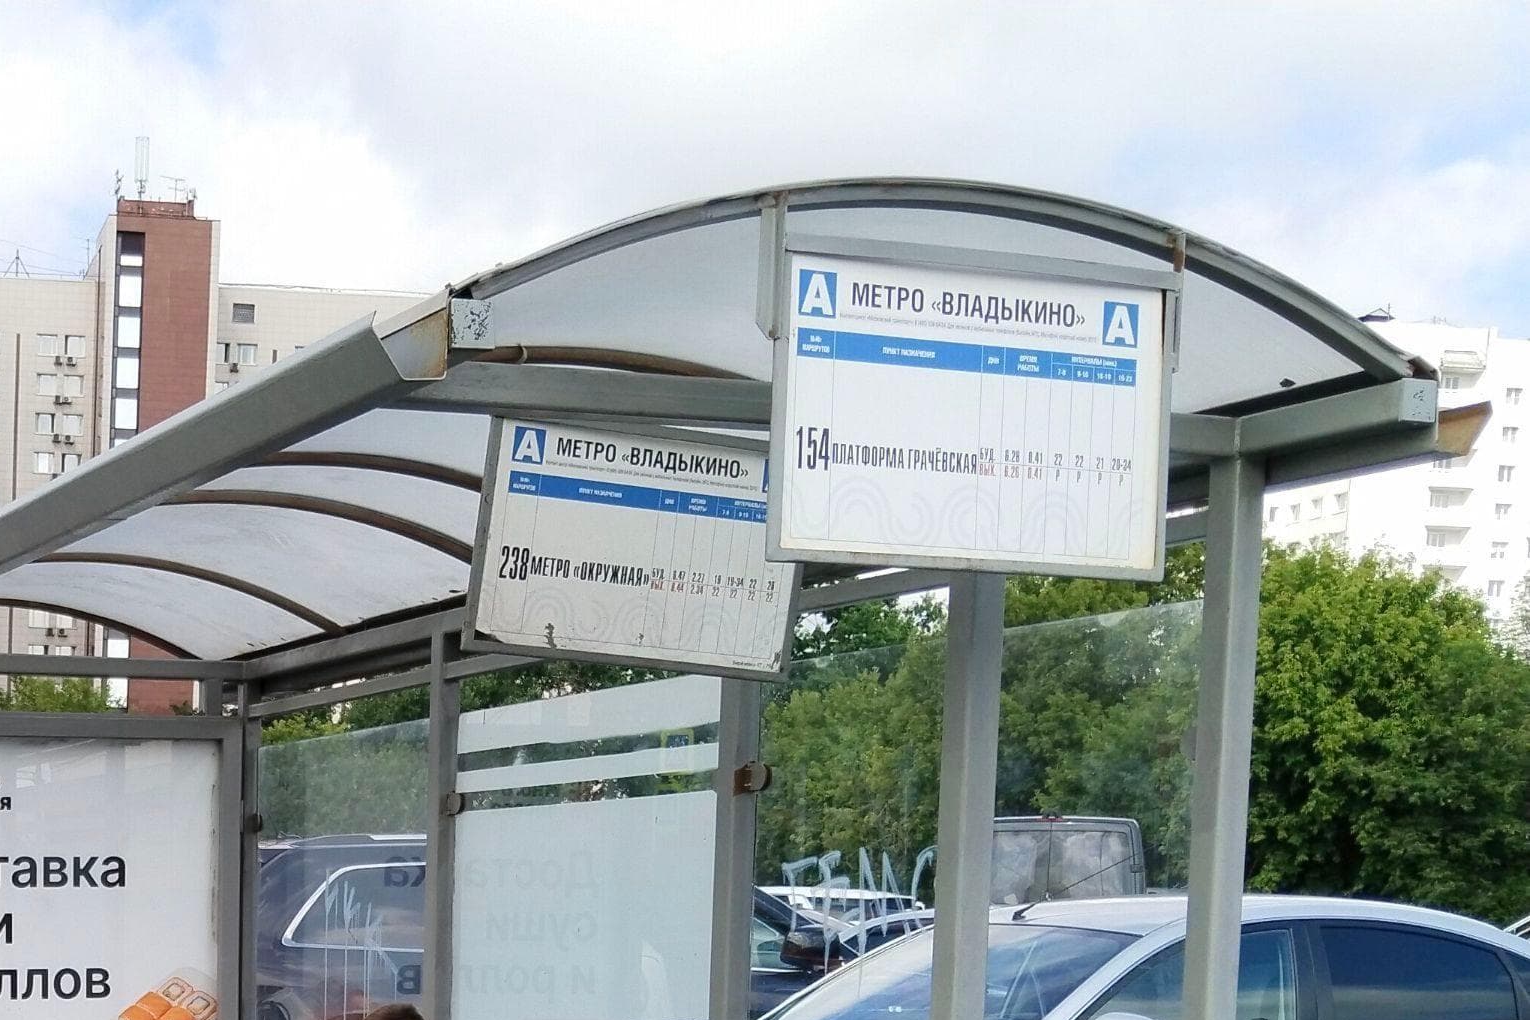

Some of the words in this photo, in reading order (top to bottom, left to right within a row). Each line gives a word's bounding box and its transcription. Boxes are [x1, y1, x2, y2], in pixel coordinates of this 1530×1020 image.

[851, 282, 924, 313] МЕТРО
[931, 291, 1086, 328] «ВЛАДЫКИНО»
[557, 437, 616, 463] МЕТРО
[621, 447, 749, 479] «ВЛАДЫКИНО»
[796, 426, 830, 471] 154
[832, 442, 904, 470] ПЛАТФОРМА
[907, 446, 977, 475] ГРАЧЁВСКАЯ
[499, 545, 530, 581] 238
[530, 555, 570, 579] МЕТРО
[573, 559, 650, 587] «ОКРУЖНАЯ»
